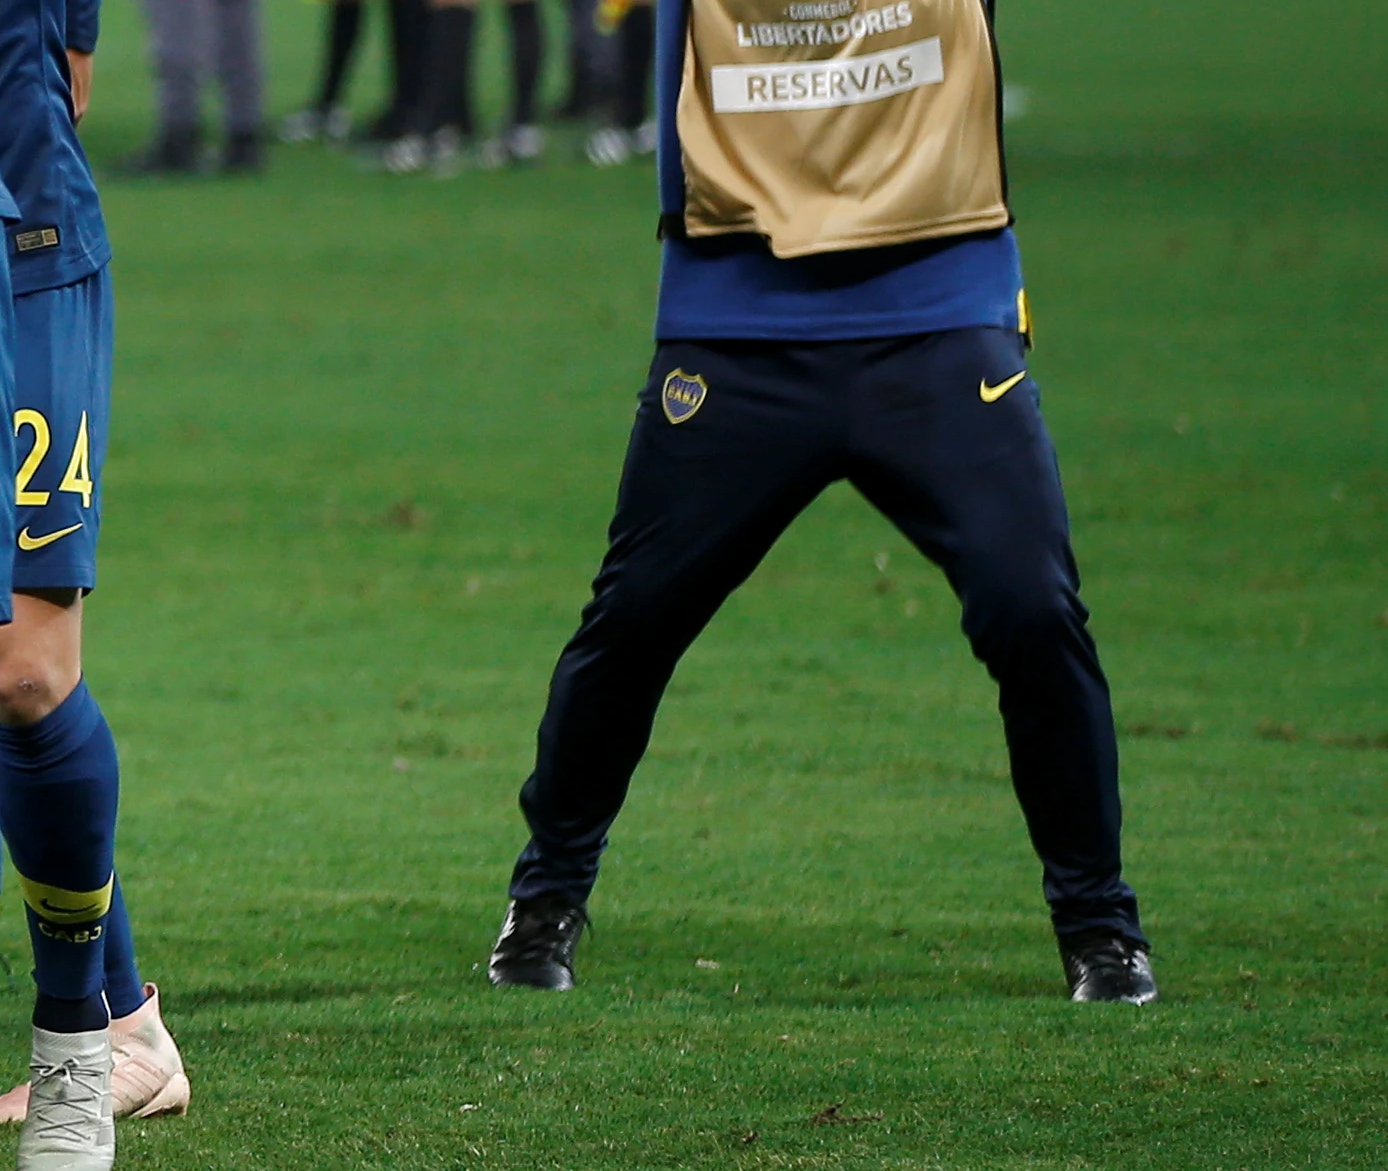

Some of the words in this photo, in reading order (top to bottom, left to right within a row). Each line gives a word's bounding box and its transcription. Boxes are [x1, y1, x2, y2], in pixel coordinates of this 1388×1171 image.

[735, 0, 914, 48] LIBERTADORES
[746, 55, 914, 103] RESERVAS
[13, 407, 94, 509] 24
